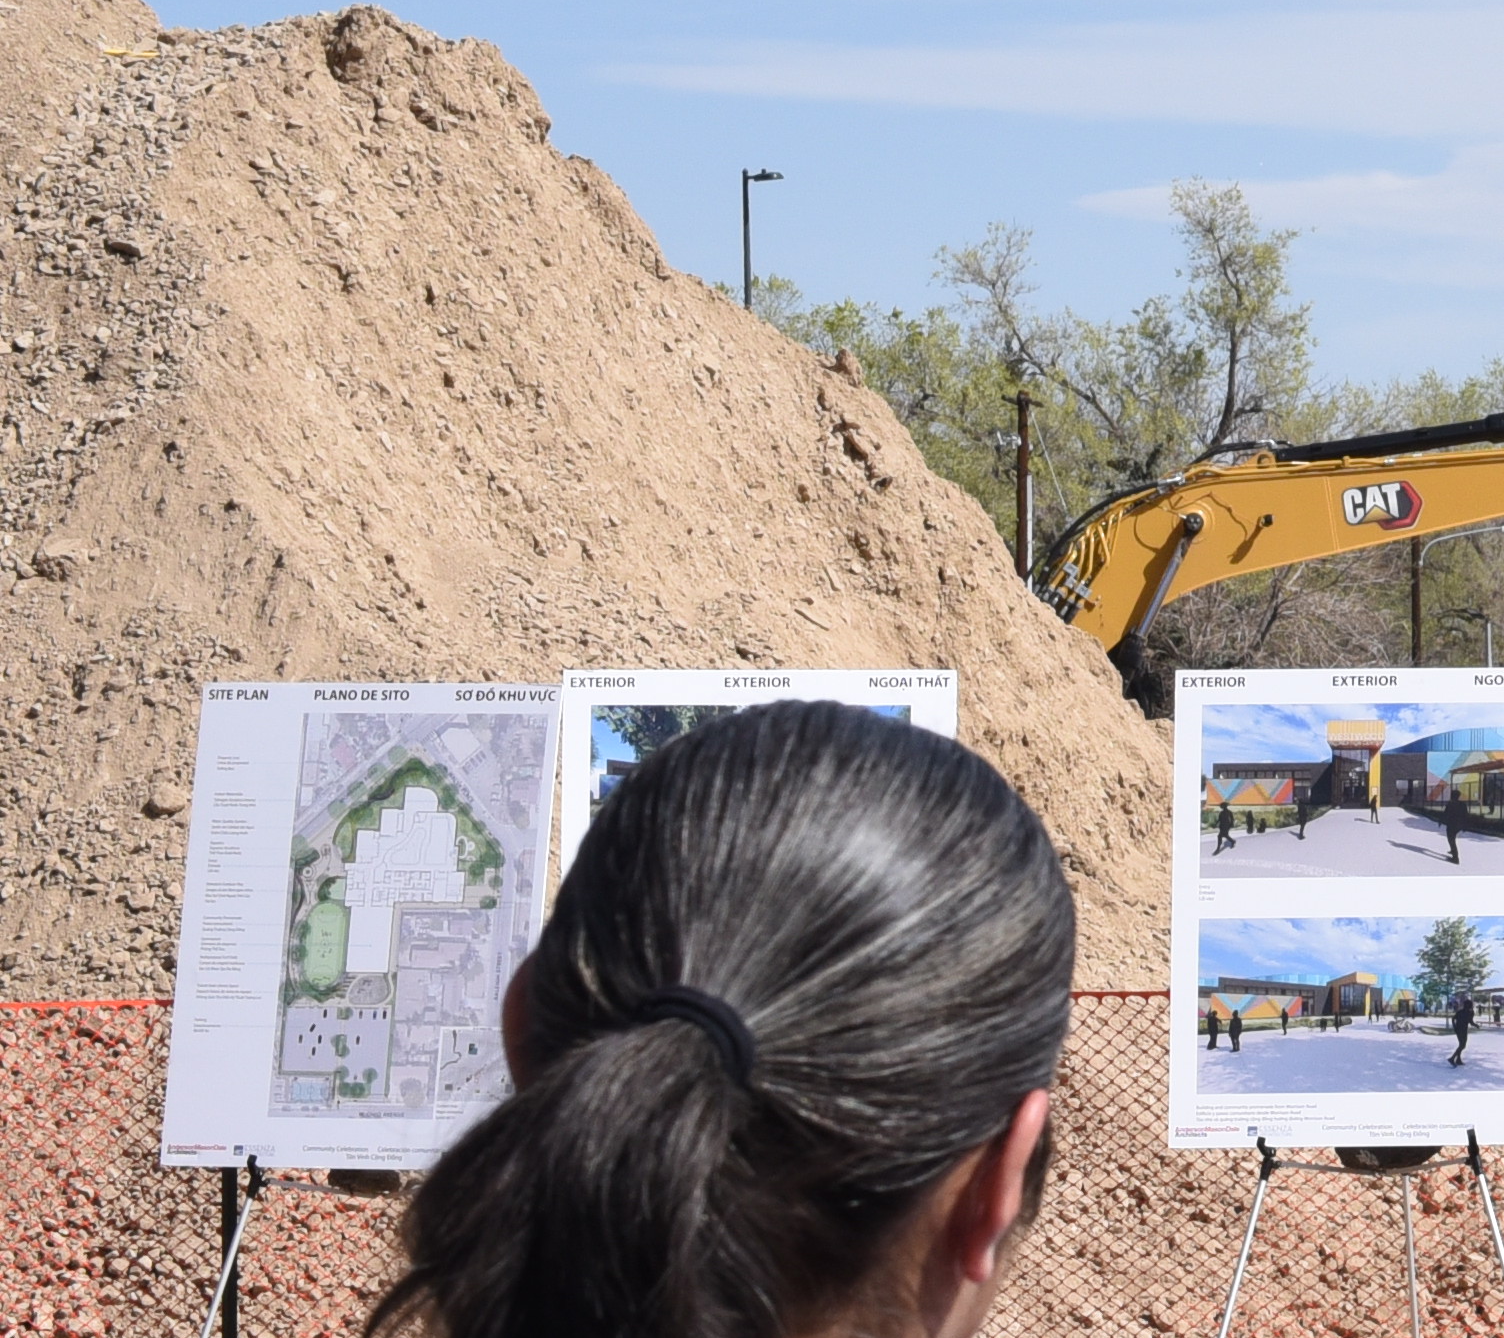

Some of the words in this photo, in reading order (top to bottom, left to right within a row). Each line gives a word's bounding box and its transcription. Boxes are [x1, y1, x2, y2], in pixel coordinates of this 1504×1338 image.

[1343, 483, 1401, 524] CAT
[570, 676, 636, 688] EXTERIOR
[724, 676, 791, 688] EXTERIOR
[1181, 676, 1246, 688] EXTERIOR
[1332, 675, 1398, 687] EXTERIOR
[208, 689, 234, 701] SITE
[236, 689, 269, 701] PLAN
[313, 689, 358, 701] PLANO
[361, 690, 379, 701] DE
[381, 690, 410, 701] SITO
[498, 690, 528, 701] KHU
